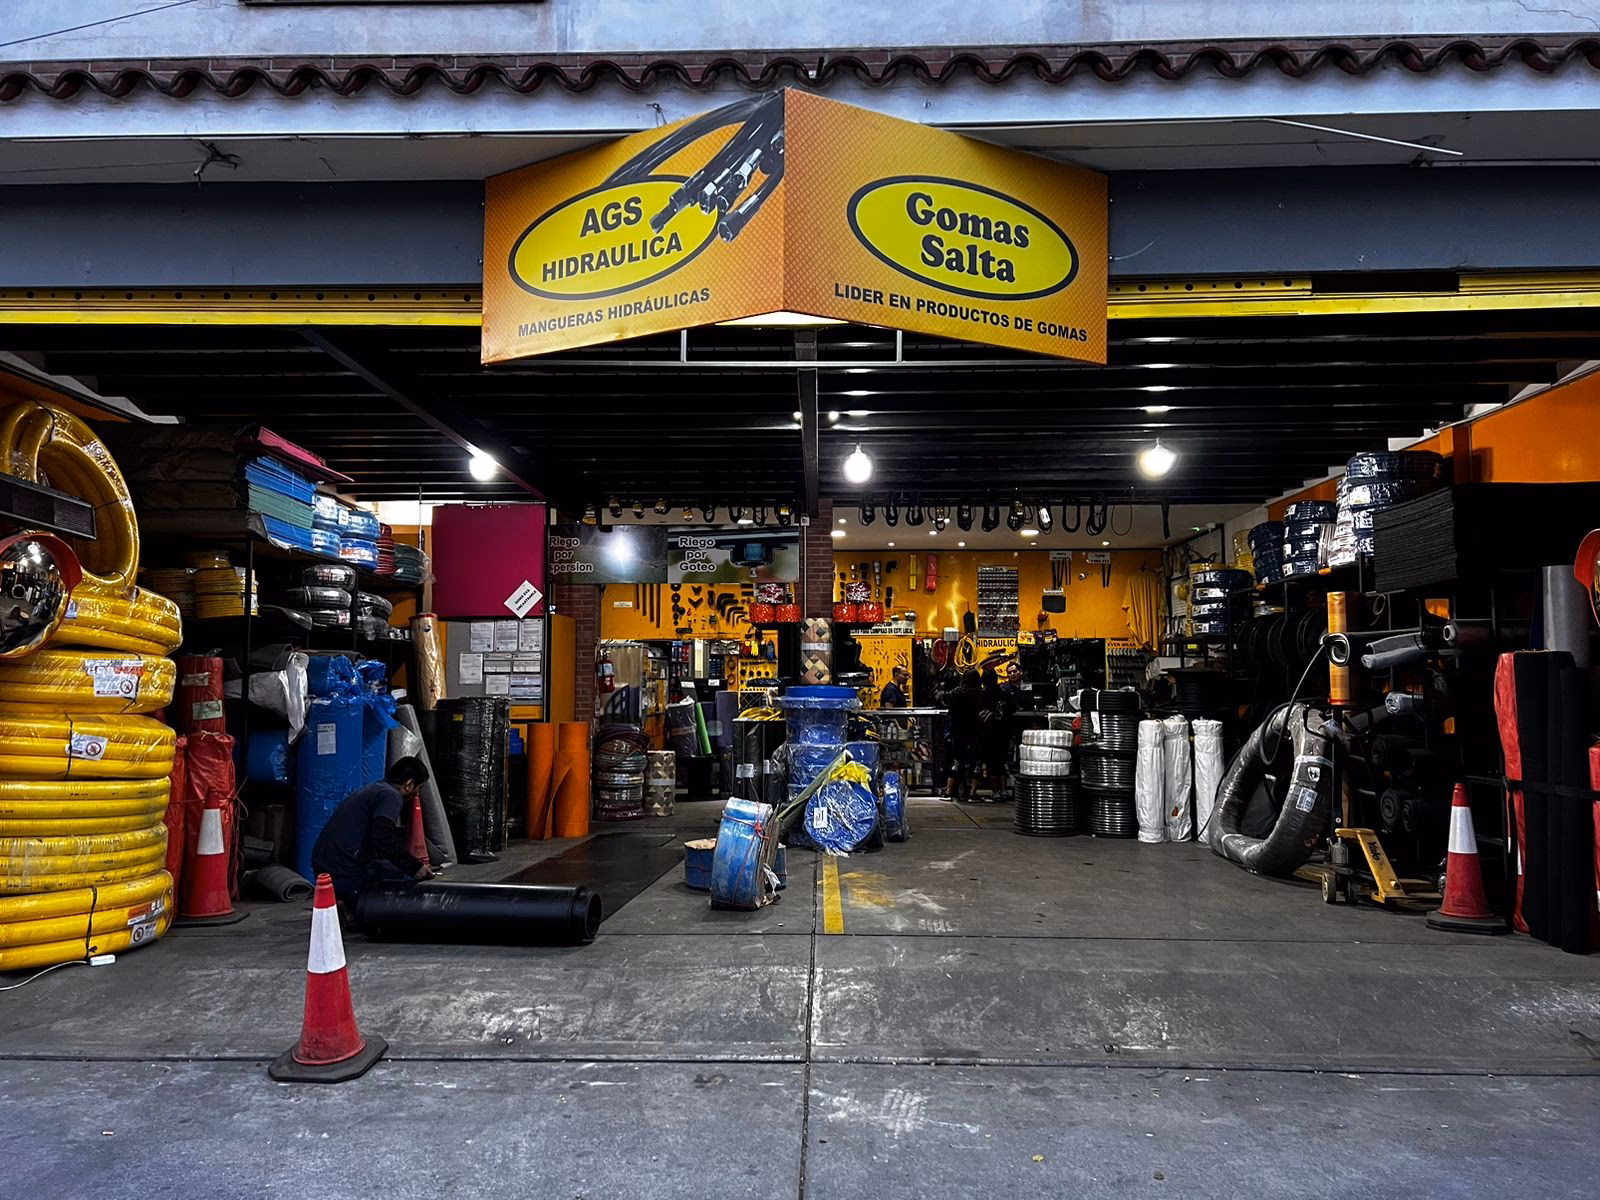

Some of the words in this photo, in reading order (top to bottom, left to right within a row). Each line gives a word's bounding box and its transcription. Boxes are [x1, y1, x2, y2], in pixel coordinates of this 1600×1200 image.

[580, 196, 642, 238] AGS
[906, 192, 1029, 249] Gomas
[542, 232, 682, 283] HIDRAULICA
[921, 234, 1016, 283] Salta
[518, 309, 603, 337] MANGUERAS
[608, 287, 710, 320] HIDRÁULICAS
[835, 283, 884, 306] LIDER
[889, 293, 911, 310] EN
[916, 299, 1010, 329] PRODUCTOS
[1014, 316, 1033, 332] DE
[1037, 321, 1088, 343] GOMAS
[551, 536, 580, 548] Riego
[554, 551, 573, 561] por
[679, 536, 715, 548] Riego
[686, 551, 707, 561] por
[679, 562, 717, 572] Goteo
[1366, 842, 1380, 861] Yale
